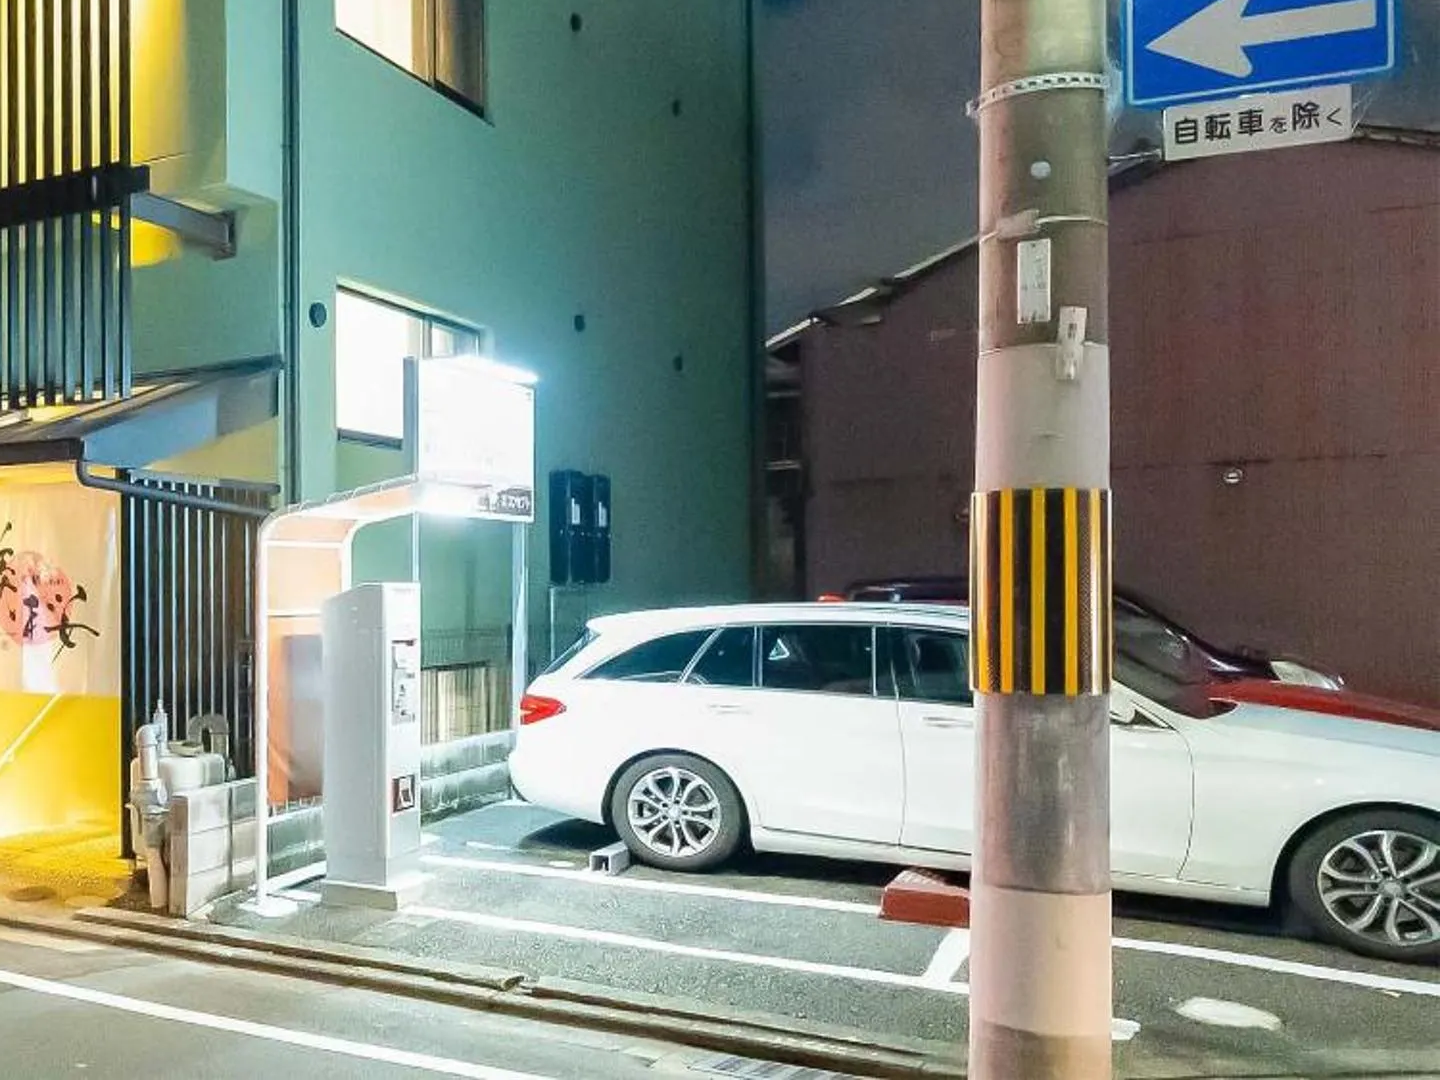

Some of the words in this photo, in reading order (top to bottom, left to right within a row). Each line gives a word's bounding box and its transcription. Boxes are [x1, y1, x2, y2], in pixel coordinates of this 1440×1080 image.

[1174, 101, 1343, 145] 自転車を除く
